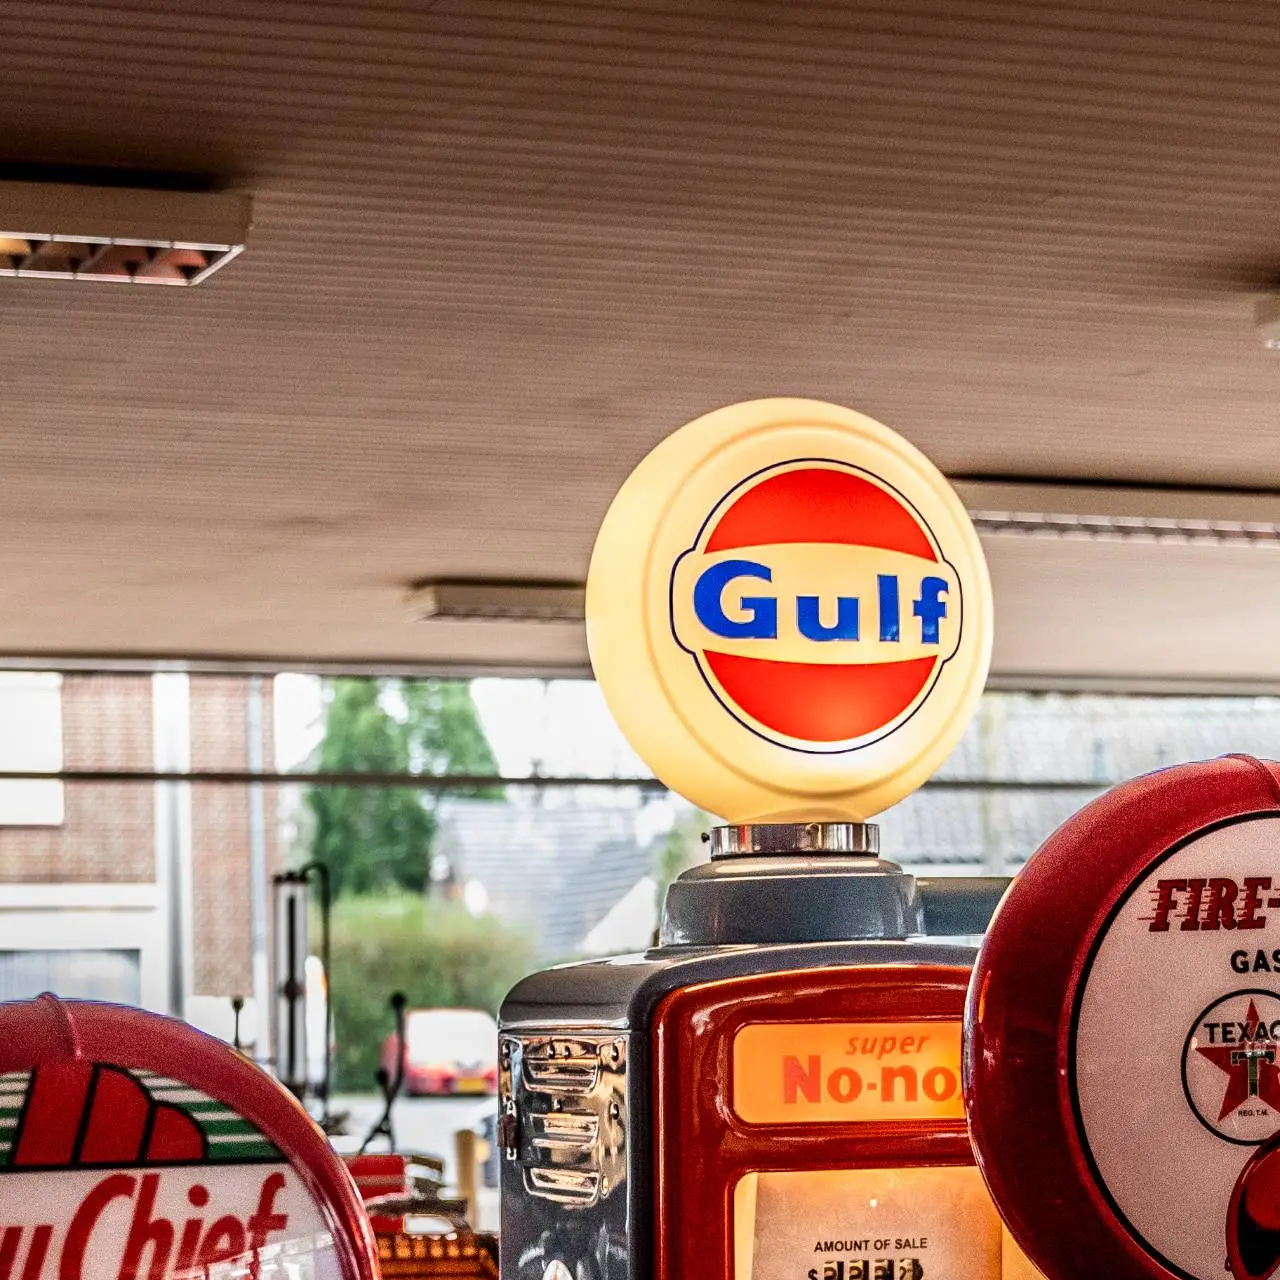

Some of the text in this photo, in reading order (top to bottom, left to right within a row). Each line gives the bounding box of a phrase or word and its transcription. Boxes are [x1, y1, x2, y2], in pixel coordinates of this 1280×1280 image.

[693, 560, 949, 645] Gulf
[846, 1035, 930, 1060] super
[783, 1055, 962, 1104] No-no
[814, 1238, 927, 1253] AMOUNT OF SALE
